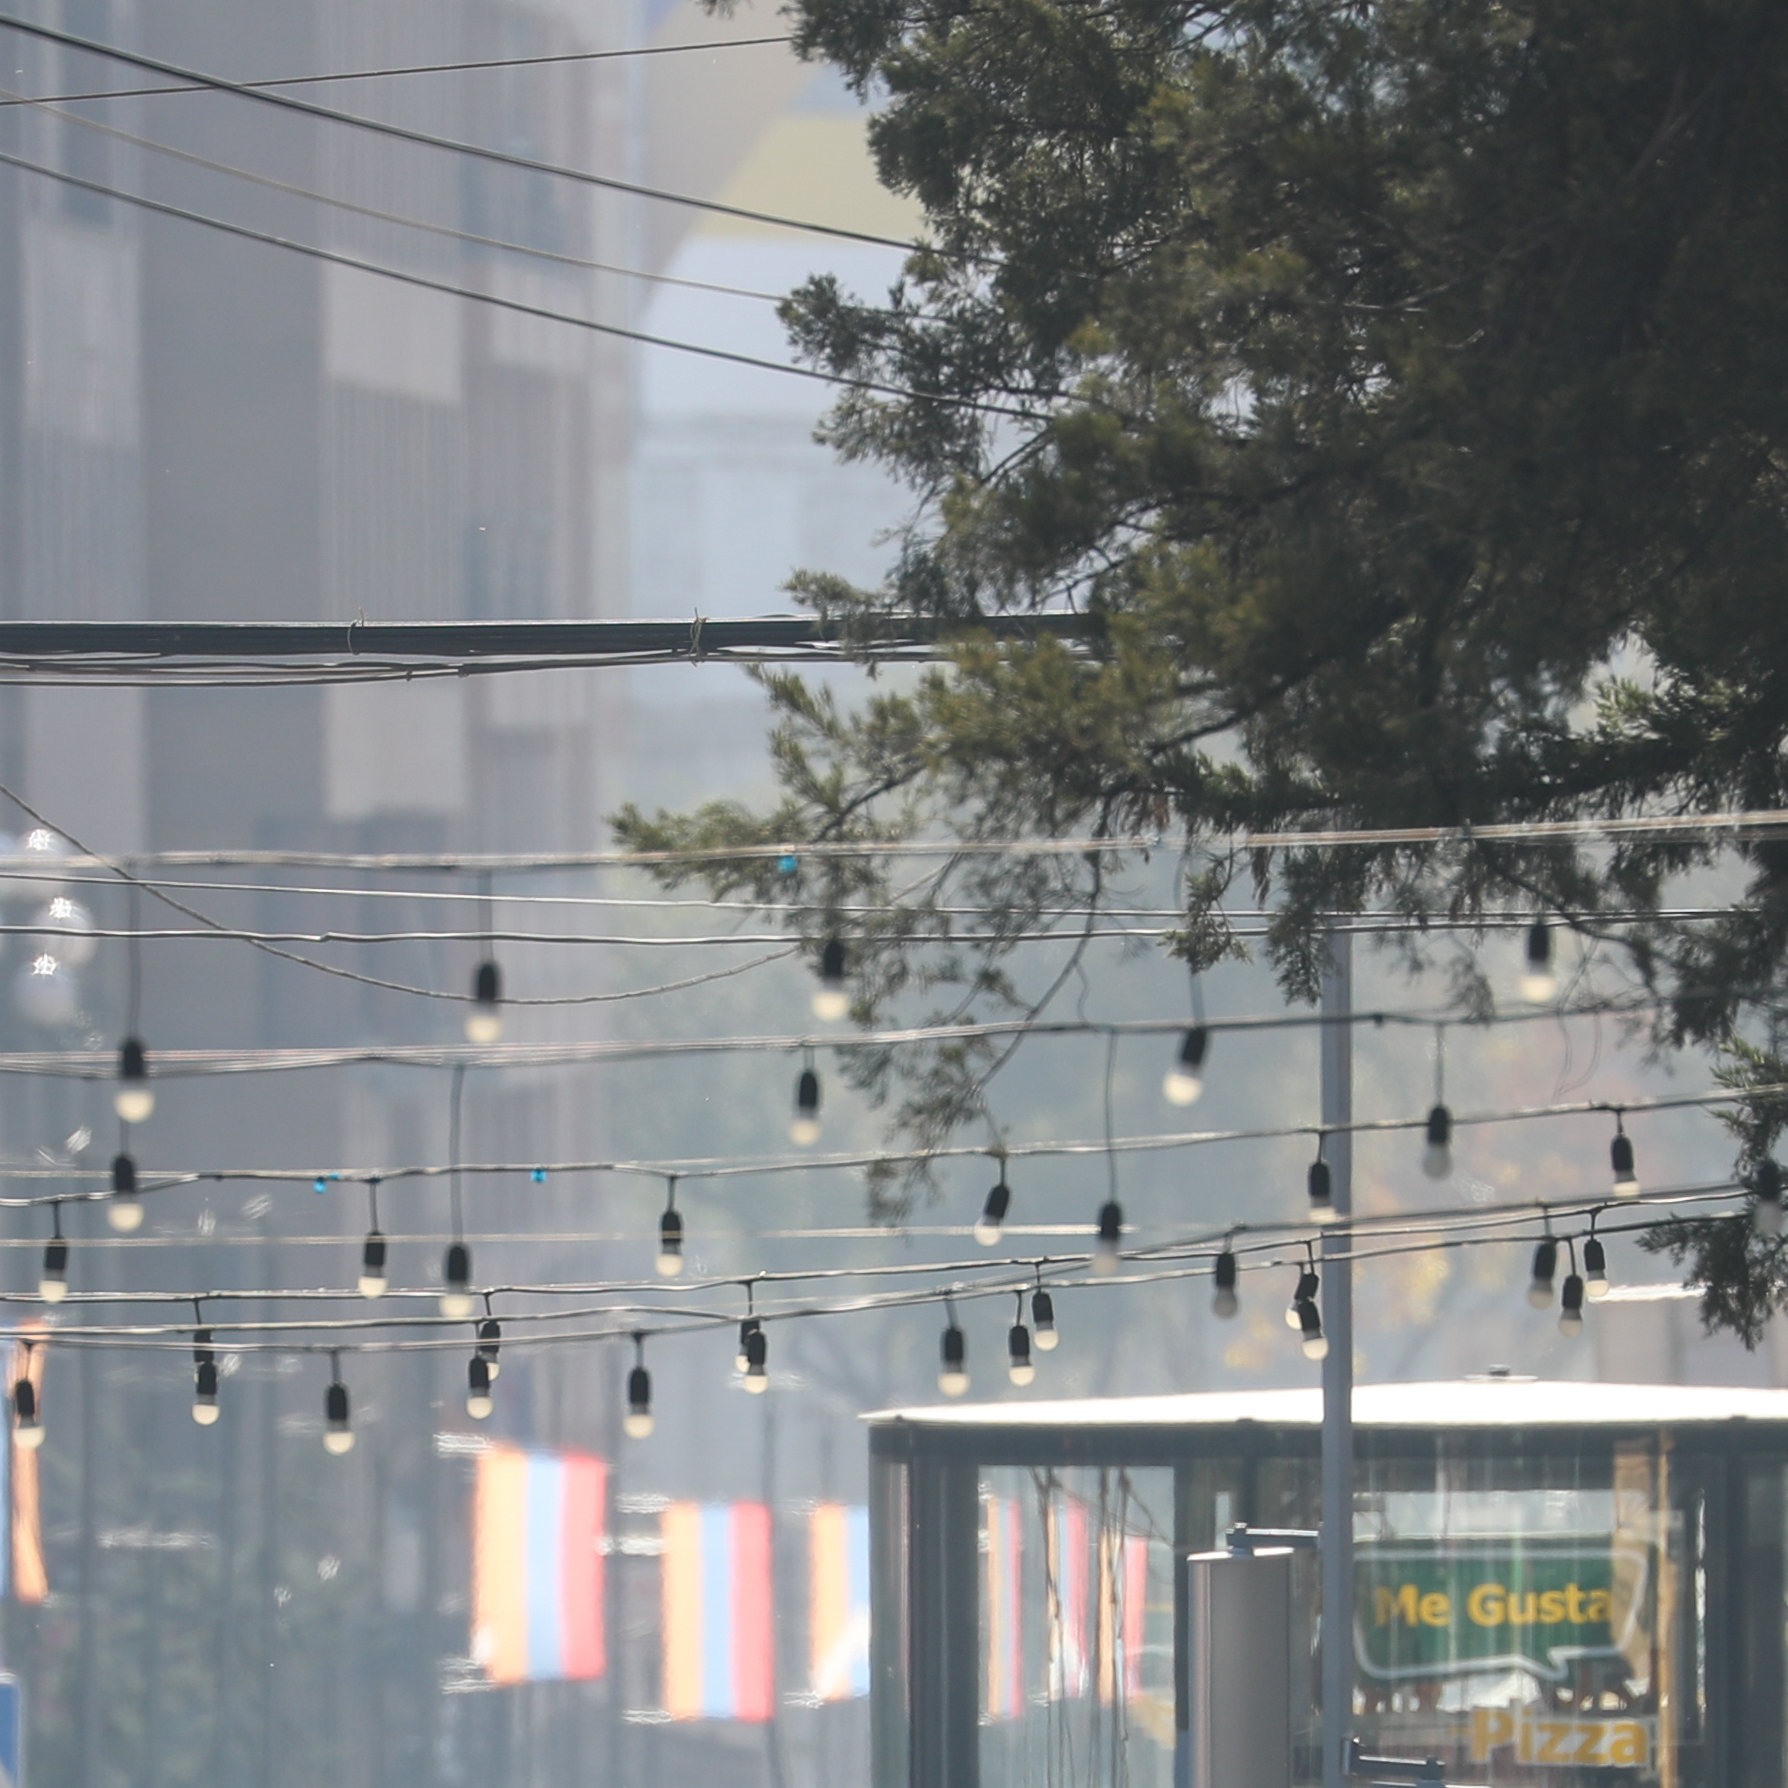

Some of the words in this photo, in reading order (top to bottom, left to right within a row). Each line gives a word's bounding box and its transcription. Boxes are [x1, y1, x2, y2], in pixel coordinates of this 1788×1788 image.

[1374, 1584, 1450, 1627] Me
[1467, 1582, 1615, 1627] Gusta
[1470, 1708, 1648, 1766] Pizza
